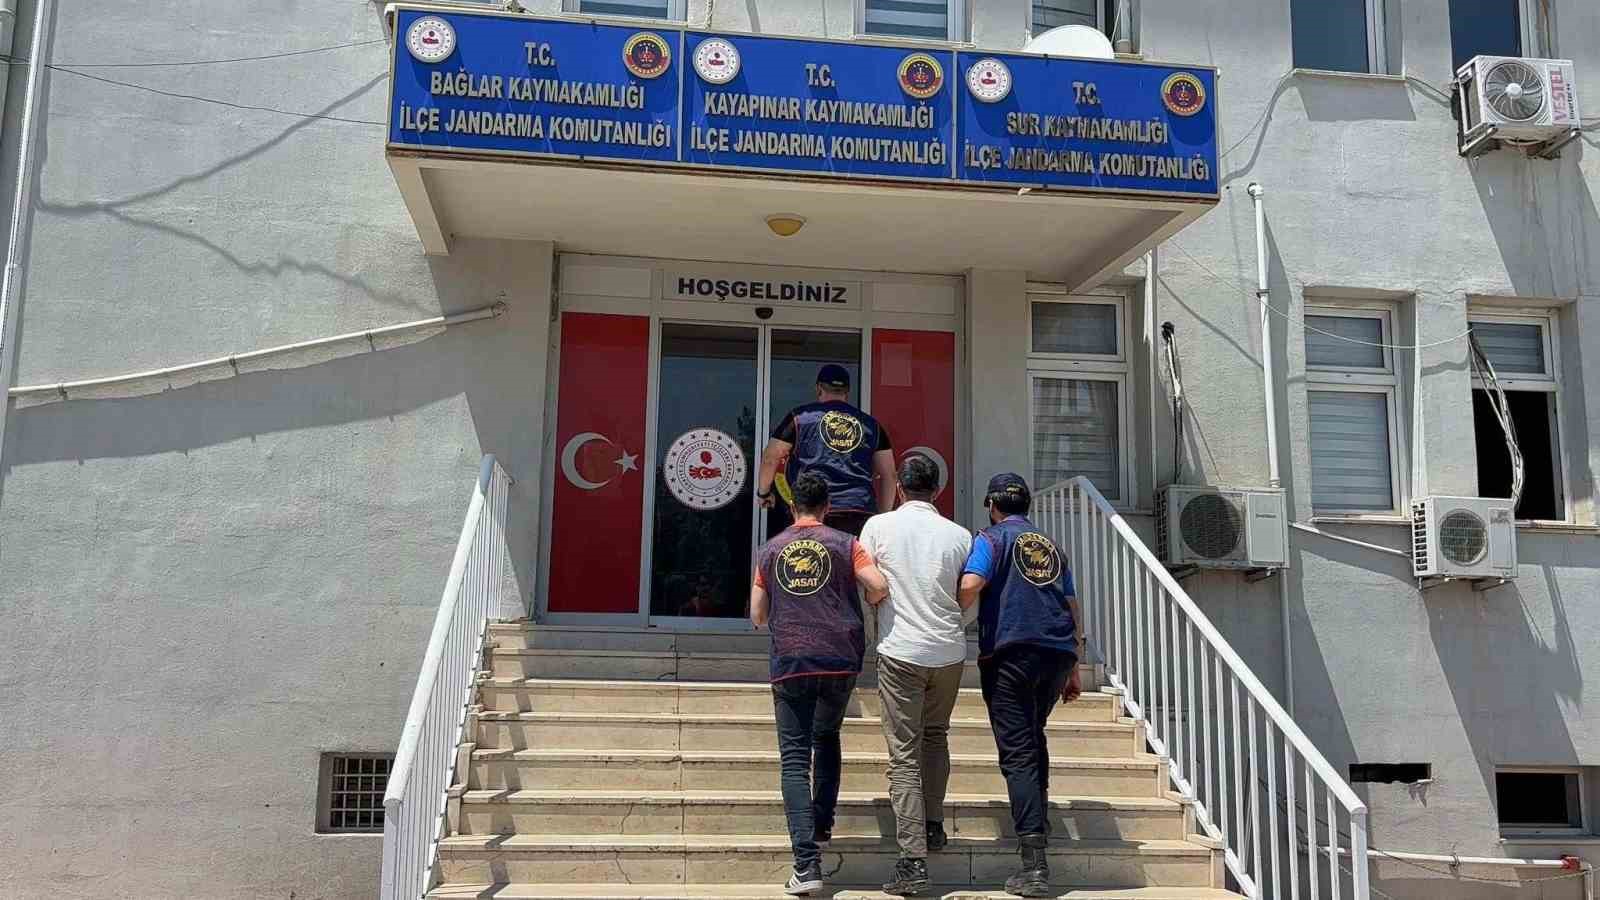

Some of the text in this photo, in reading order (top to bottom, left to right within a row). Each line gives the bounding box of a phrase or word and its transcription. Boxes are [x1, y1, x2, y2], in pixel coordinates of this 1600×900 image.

[524, 41, 555, 66] T.C.
[431, 67, 645, 110] BAĞLAR KAYMAKAMLIĞI
[805, 63, 835, 87] T.C.
[1072, 81, 1102, 105] T.C.
[399, 100, 671, 148] İLÇE JANDARMA KOMUTANLIĞI
[705, 91, 934, 129] KAYAPINAR KAYMAKAMLIĞI
[1006, 111, 1169, 144] SUR KAYMAKAMLIĞI
[690, 121, 946, 165] İLÇE JANDARMA KOMUTANLIĞI
[964, 139, 1210, 181] İLÇE JANDARMA KOMUTANLIĞI
[678, 276, 847, 304] HOŞGELDİNİZ
[780, 539, 827, 561] JANDARMA
[788, 577, 819, 589] JASAT
